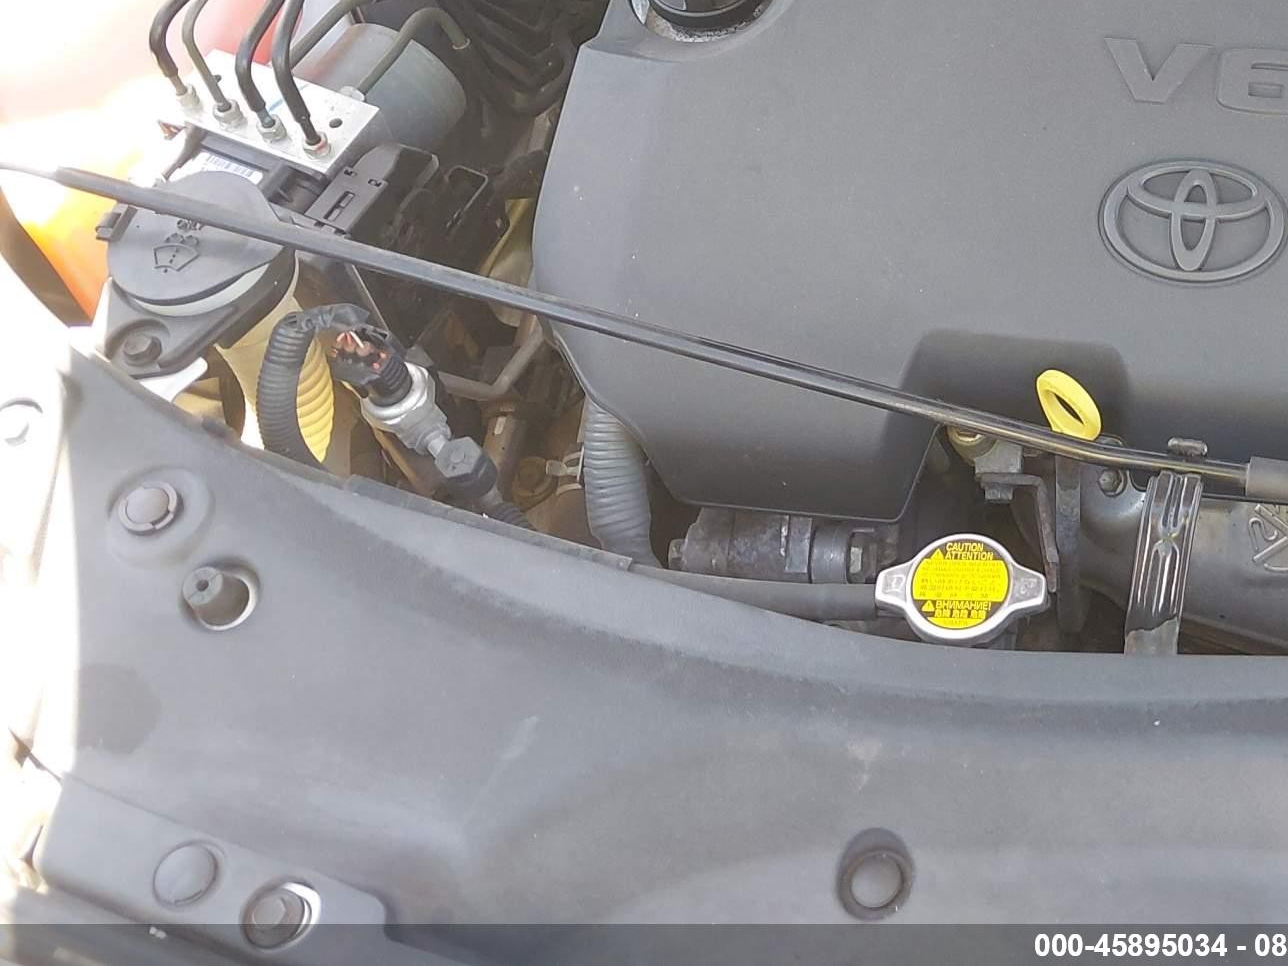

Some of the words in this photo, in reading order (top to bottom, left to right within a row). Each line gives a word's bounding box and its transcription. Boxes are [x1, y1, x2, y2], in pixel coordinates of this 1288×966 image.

[945, 542, 984, 552] CAUTION
[944, 552, 994, 561] ATTENTION
[935, 600, 992, 611] ВНИМАНИЕ!
